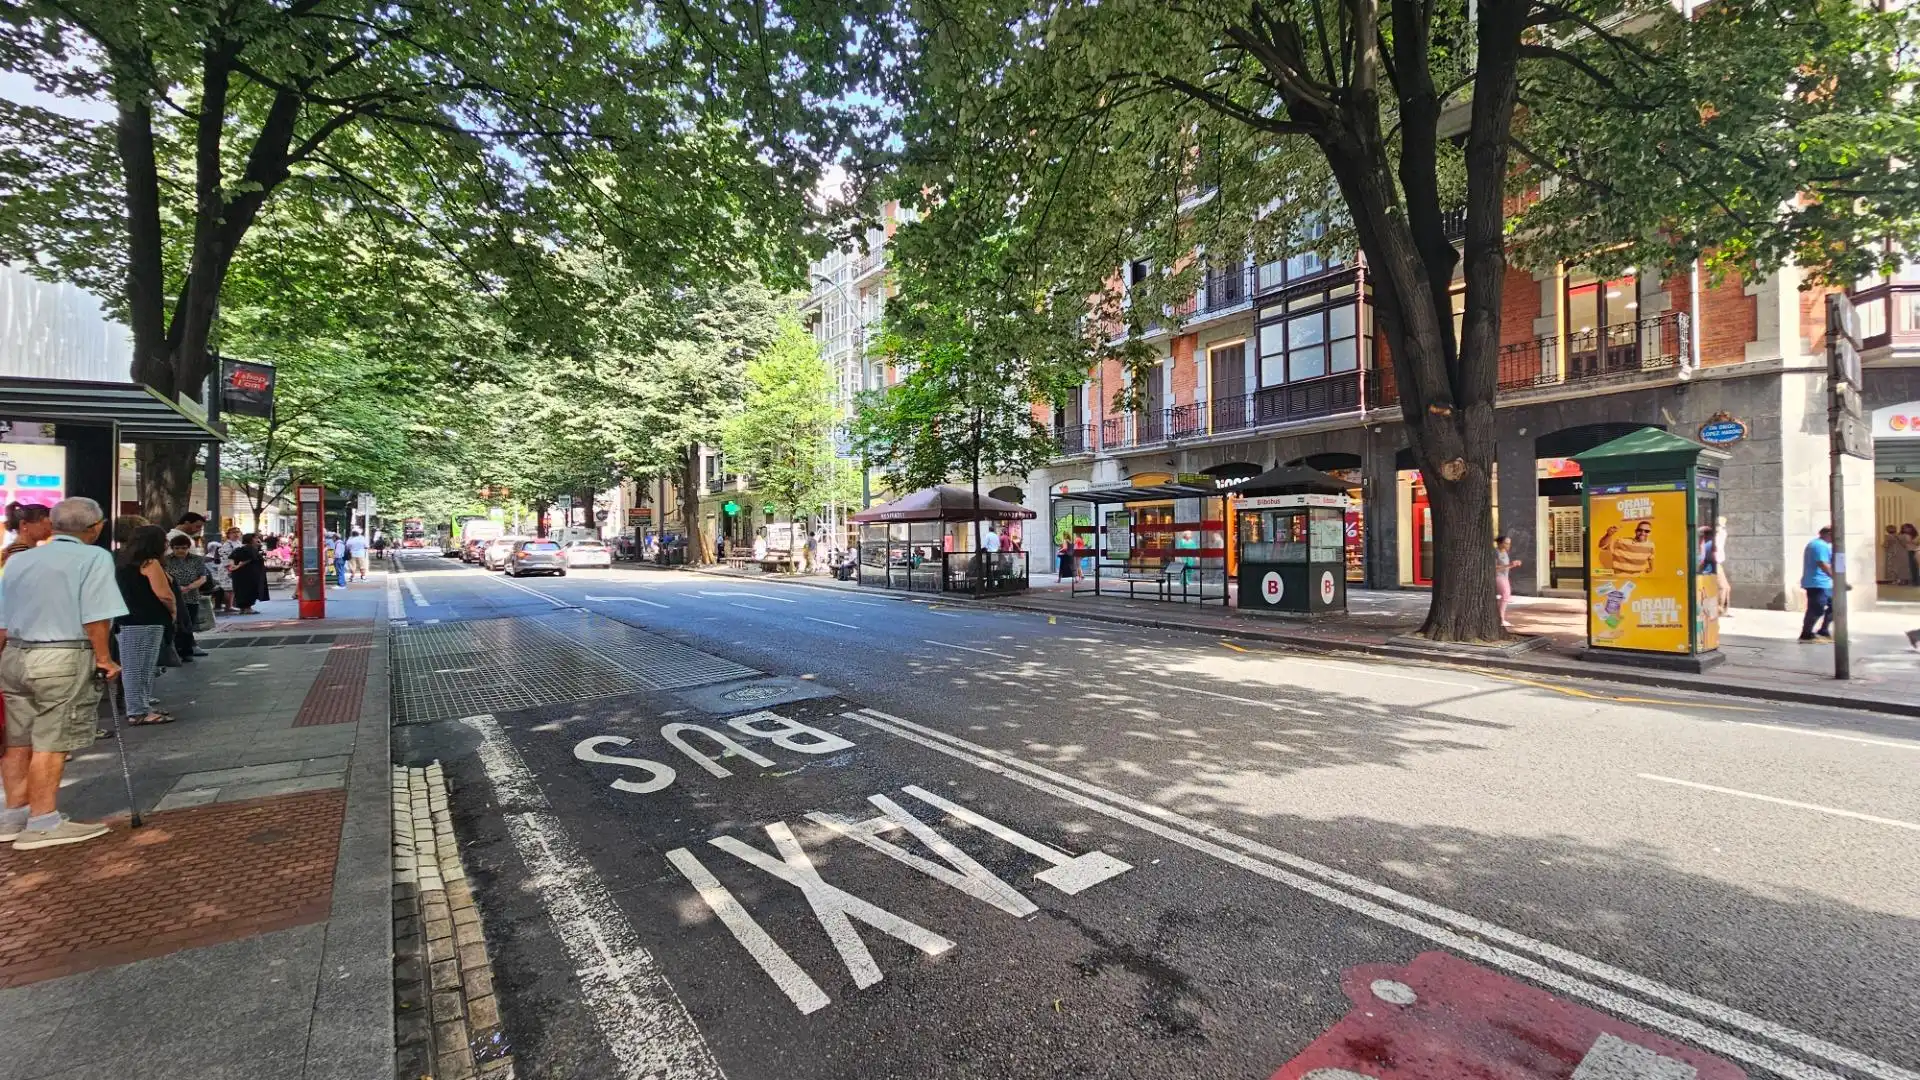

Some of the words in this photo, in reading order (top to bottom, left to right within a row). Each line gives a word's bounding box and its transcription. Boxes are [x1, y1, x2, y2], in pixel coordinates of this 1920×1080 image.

[1268, 580, 1278, 594] B
[573, 711, 856, 794] BUS
[665, 785, 1134, 1015] TAXI
